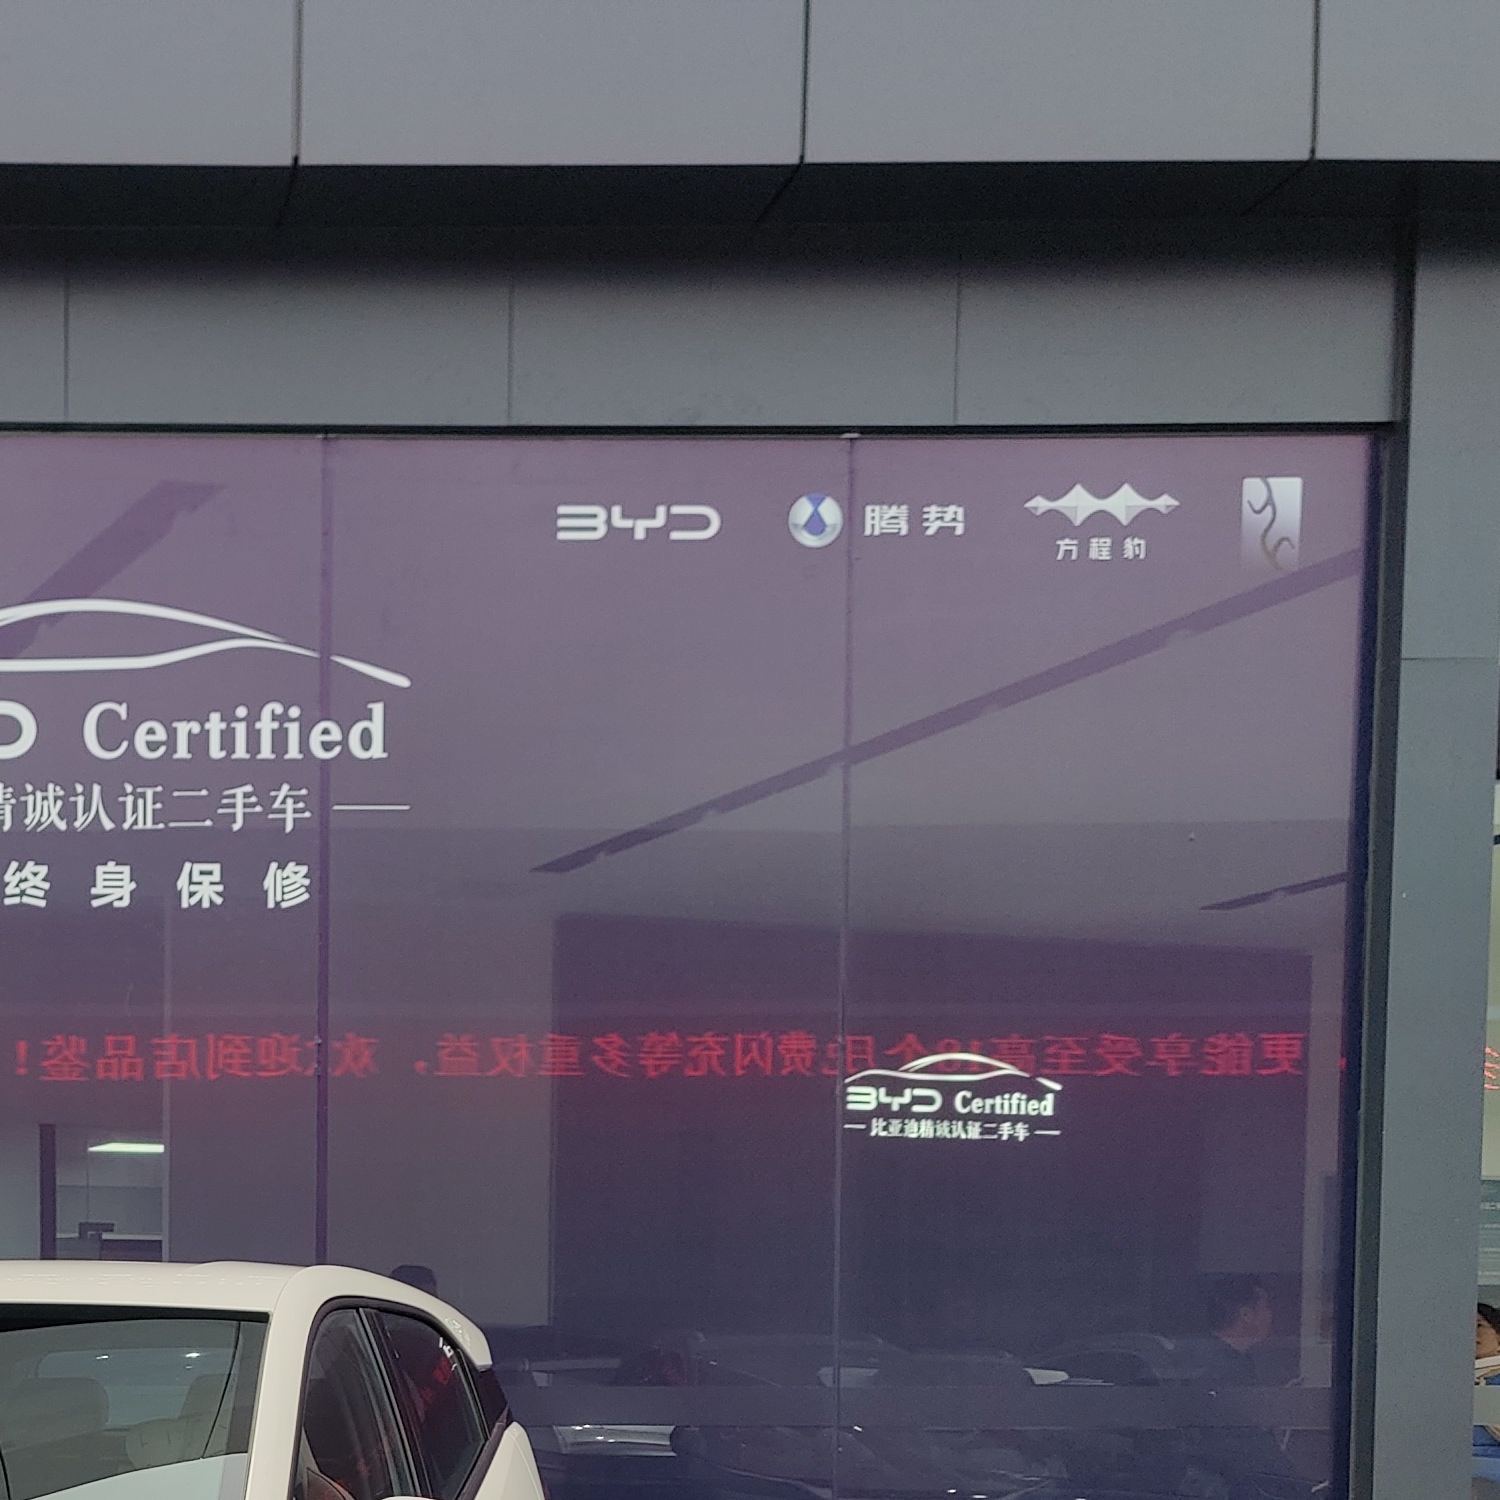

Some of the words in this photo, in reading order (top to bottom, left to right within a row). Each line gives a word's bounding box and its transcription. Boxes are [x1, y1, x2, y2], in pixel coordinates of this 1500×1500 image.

[555, 504, 722, 542] BYD
[863, 503, 966, 537] 腾势
[1054, 536, 1148, 562] 方程豹
[82, 700, 389, 761] Certified
[845, 1085, 943, 1113] BYD
[954, 1089, 1055, 1117] Certified
[869, 1116, 1031, 1142] 比亚迪精诚认证二手车
